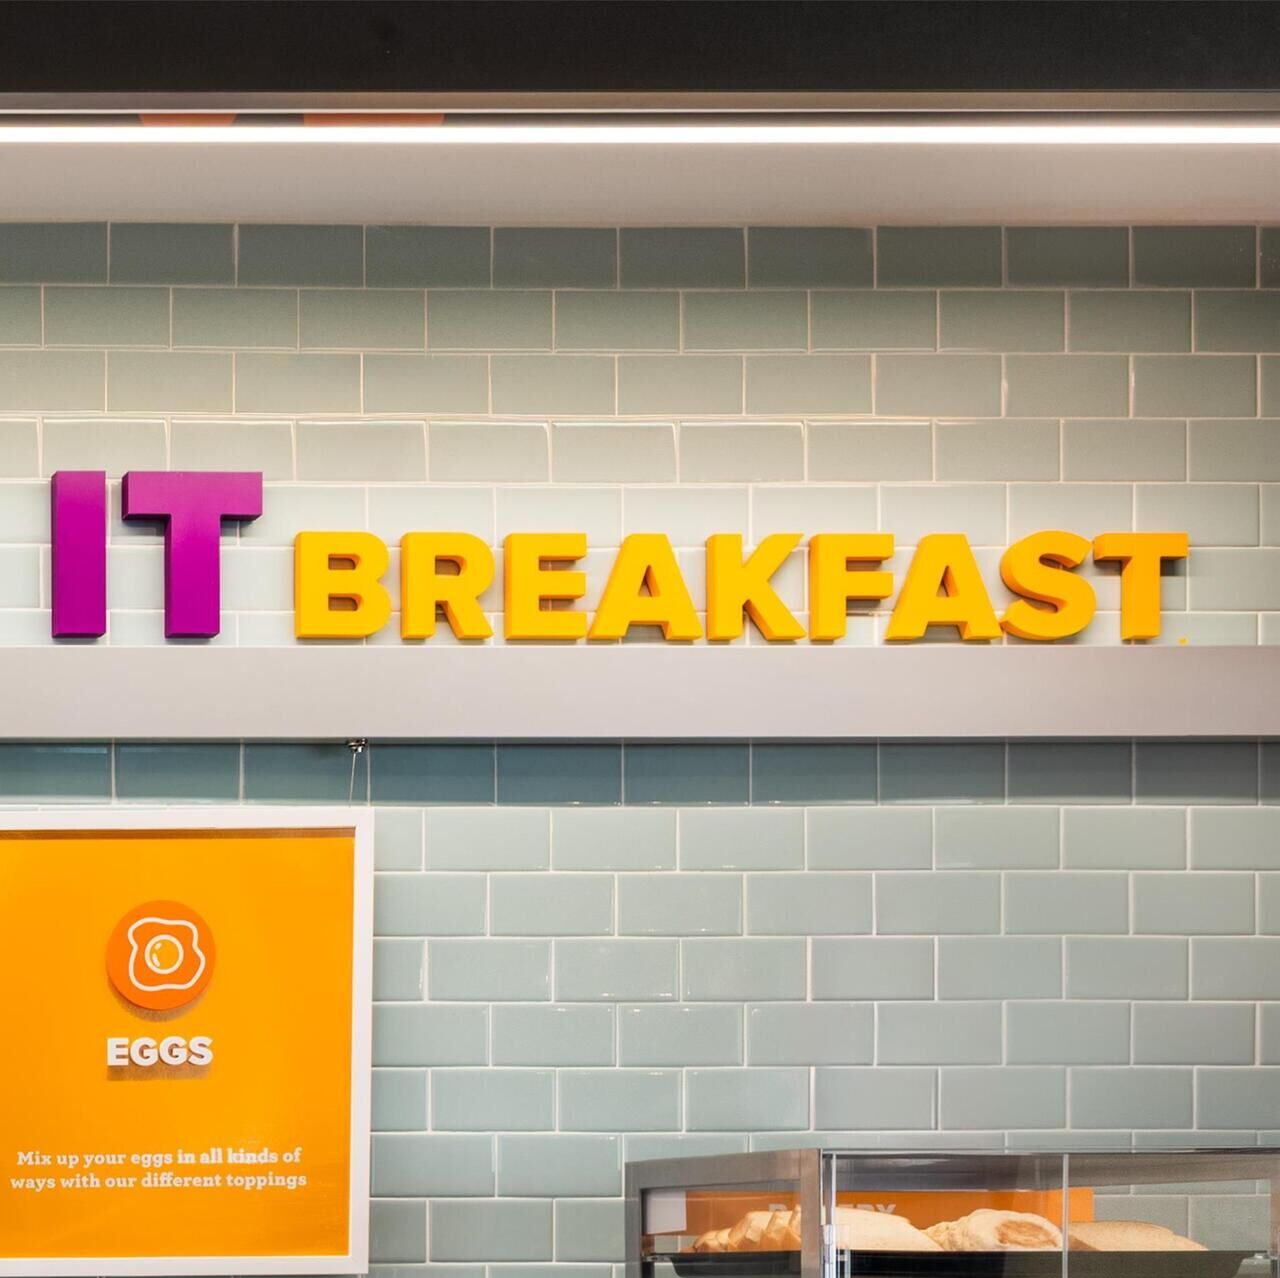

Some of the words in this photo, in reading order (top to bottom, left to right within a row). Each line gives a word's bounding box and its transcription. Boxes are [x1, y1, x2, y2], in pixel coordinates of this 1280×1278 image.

[50, 470, 263, 640] IT
[293, 530, 1190, 643] BREAKFAST
[107, 1036, 214, 1067] EGGS
[16, 1150, 52, 1166] Mix
[56, 1154, 80, 1168] up
[83, 1153, 126, 1168] your
[130, 1153, 173, 1168] eggs
[177, 1149, 196, 1164] in
[199, 1148, 223, 1164] all
[227, 1147, 278, 1164] kinds
[282, 1147, 302, 1164] of
[10, 1176, 56, 1192] ways
[60, 1172, 101, 1189] with
[104, 1176, 137, 1188] our
[141, 1171, 221, 1188] different
[225, 1171, 307, 1190] toppings
